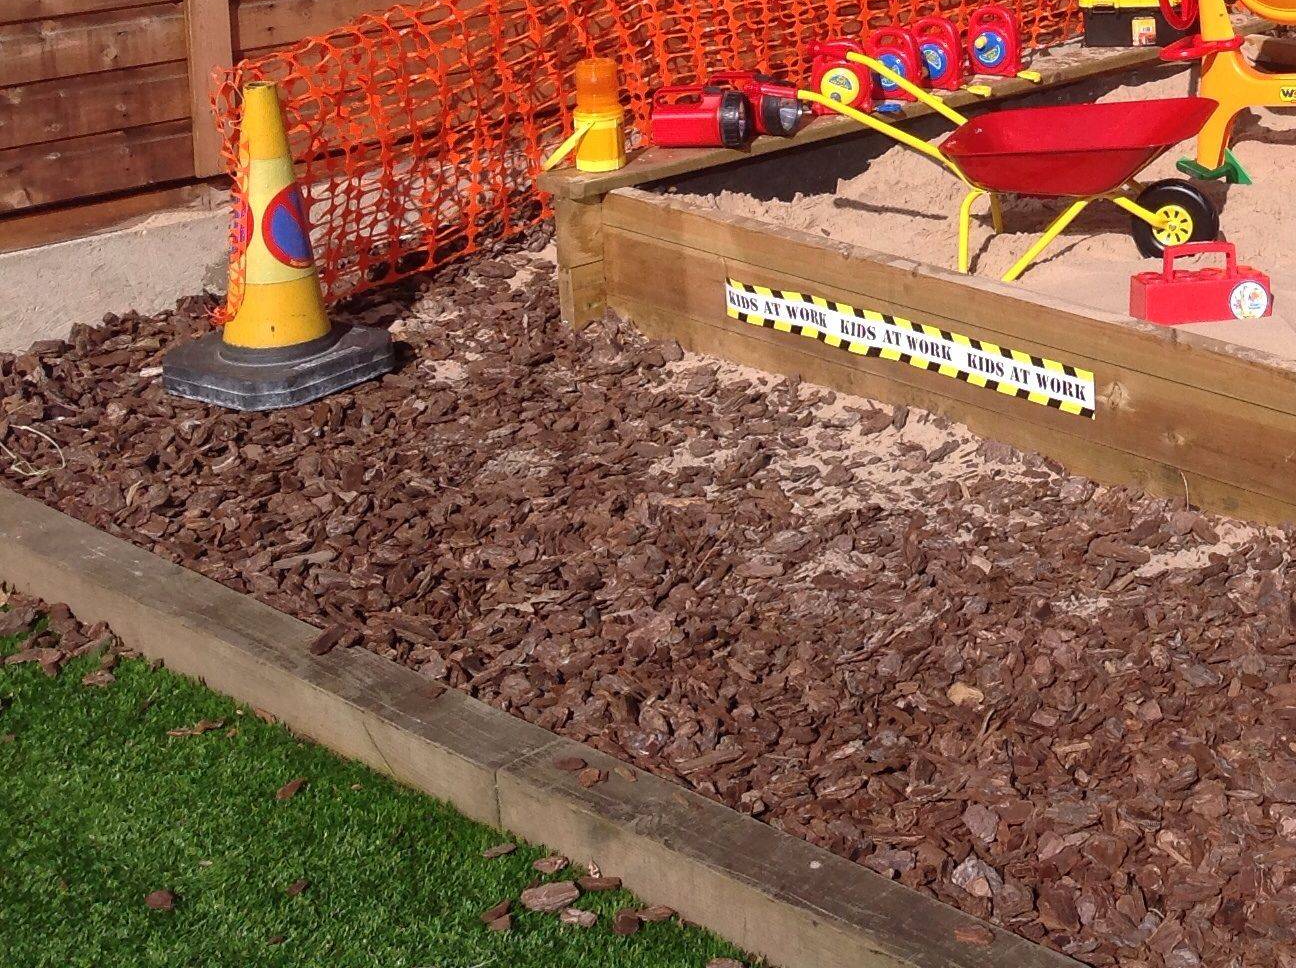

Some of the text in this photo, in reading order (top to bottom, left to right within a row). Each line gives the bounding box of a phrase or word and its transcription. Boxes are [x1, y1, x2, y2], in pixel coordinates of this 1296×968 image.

[728, 290, 1087, 402] KIDS AT WORK KIDS AT WORK KIDS AT WORK
